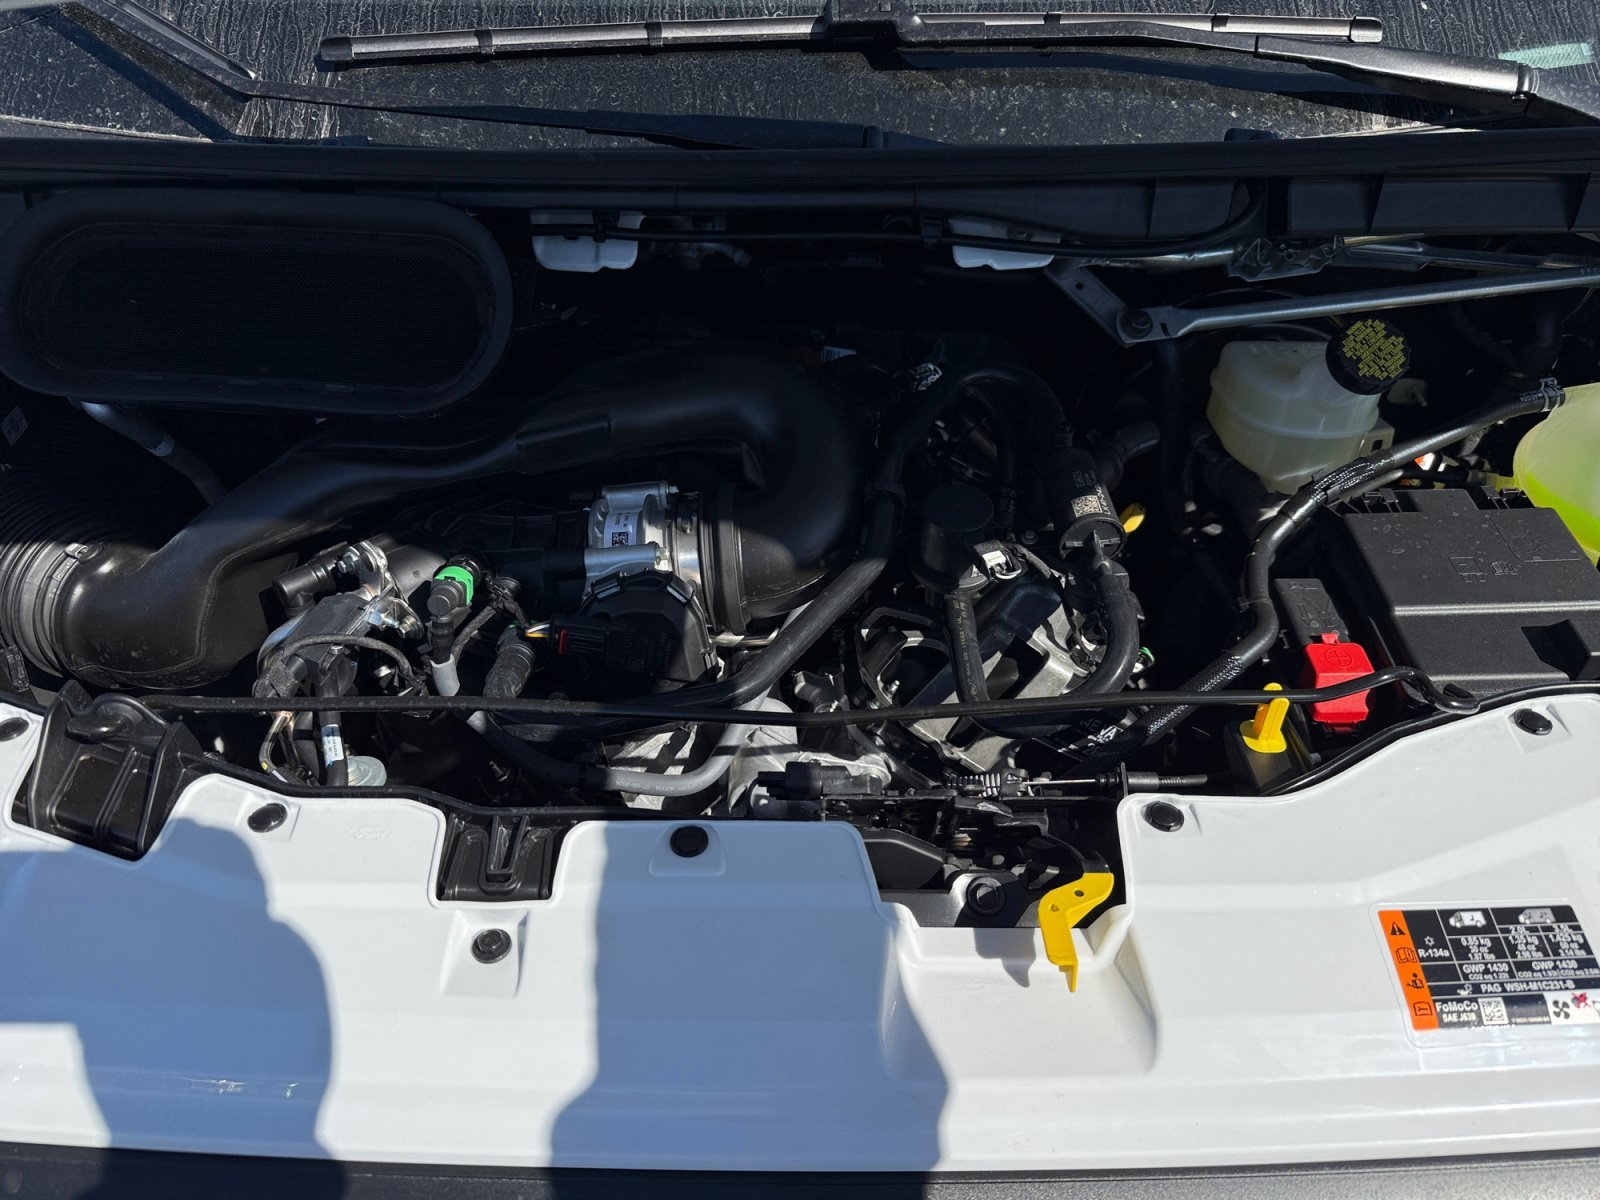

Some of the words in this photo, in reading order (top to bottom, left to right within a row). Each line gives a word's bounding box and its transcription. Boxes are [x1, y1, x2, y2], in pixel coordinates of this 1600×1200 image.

[1418, 948, 1450, 958] R-134a
[1463, 963, 1485, 974] GWP
[1487, 962, 1509, 973] 1430
[1532, 960, 1554, 971] GWP
[1556, 959, 1578, 970] 1430
[1480, 983, 1502, 993] PAG
[1504, 980, 1576, 993] WSH-M1C231-B
[1435, 1001, 1479, 1012] FoMoCo
[1442, 1012, 1458, 1022] SAE
